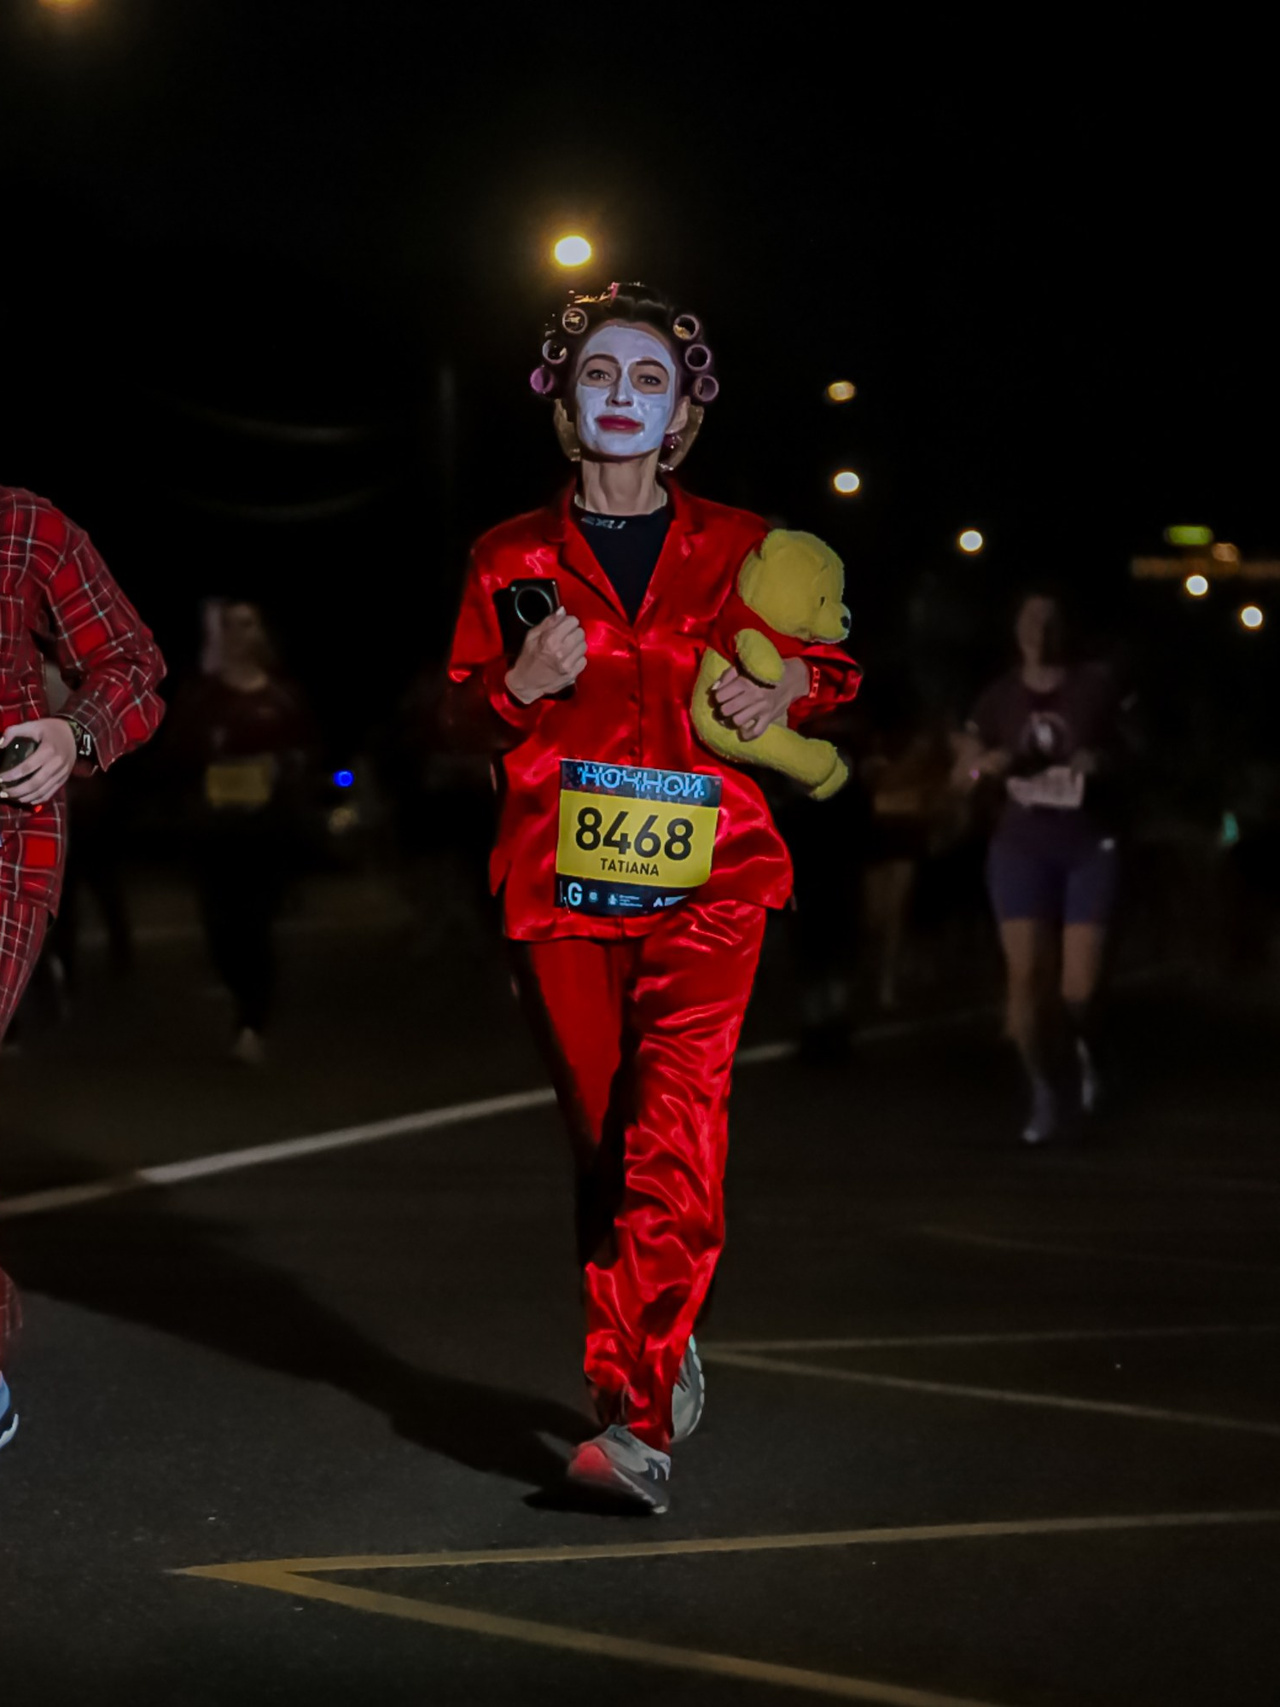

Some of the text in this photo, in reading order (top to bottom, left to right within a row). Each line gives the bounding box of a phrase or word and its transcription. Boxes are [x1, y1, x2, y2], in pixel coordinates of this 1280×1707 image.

[575, 806, 694, 861] 8468
[600, 857, 659, 876] TATIANA
[567, 882, 583, 906] G
